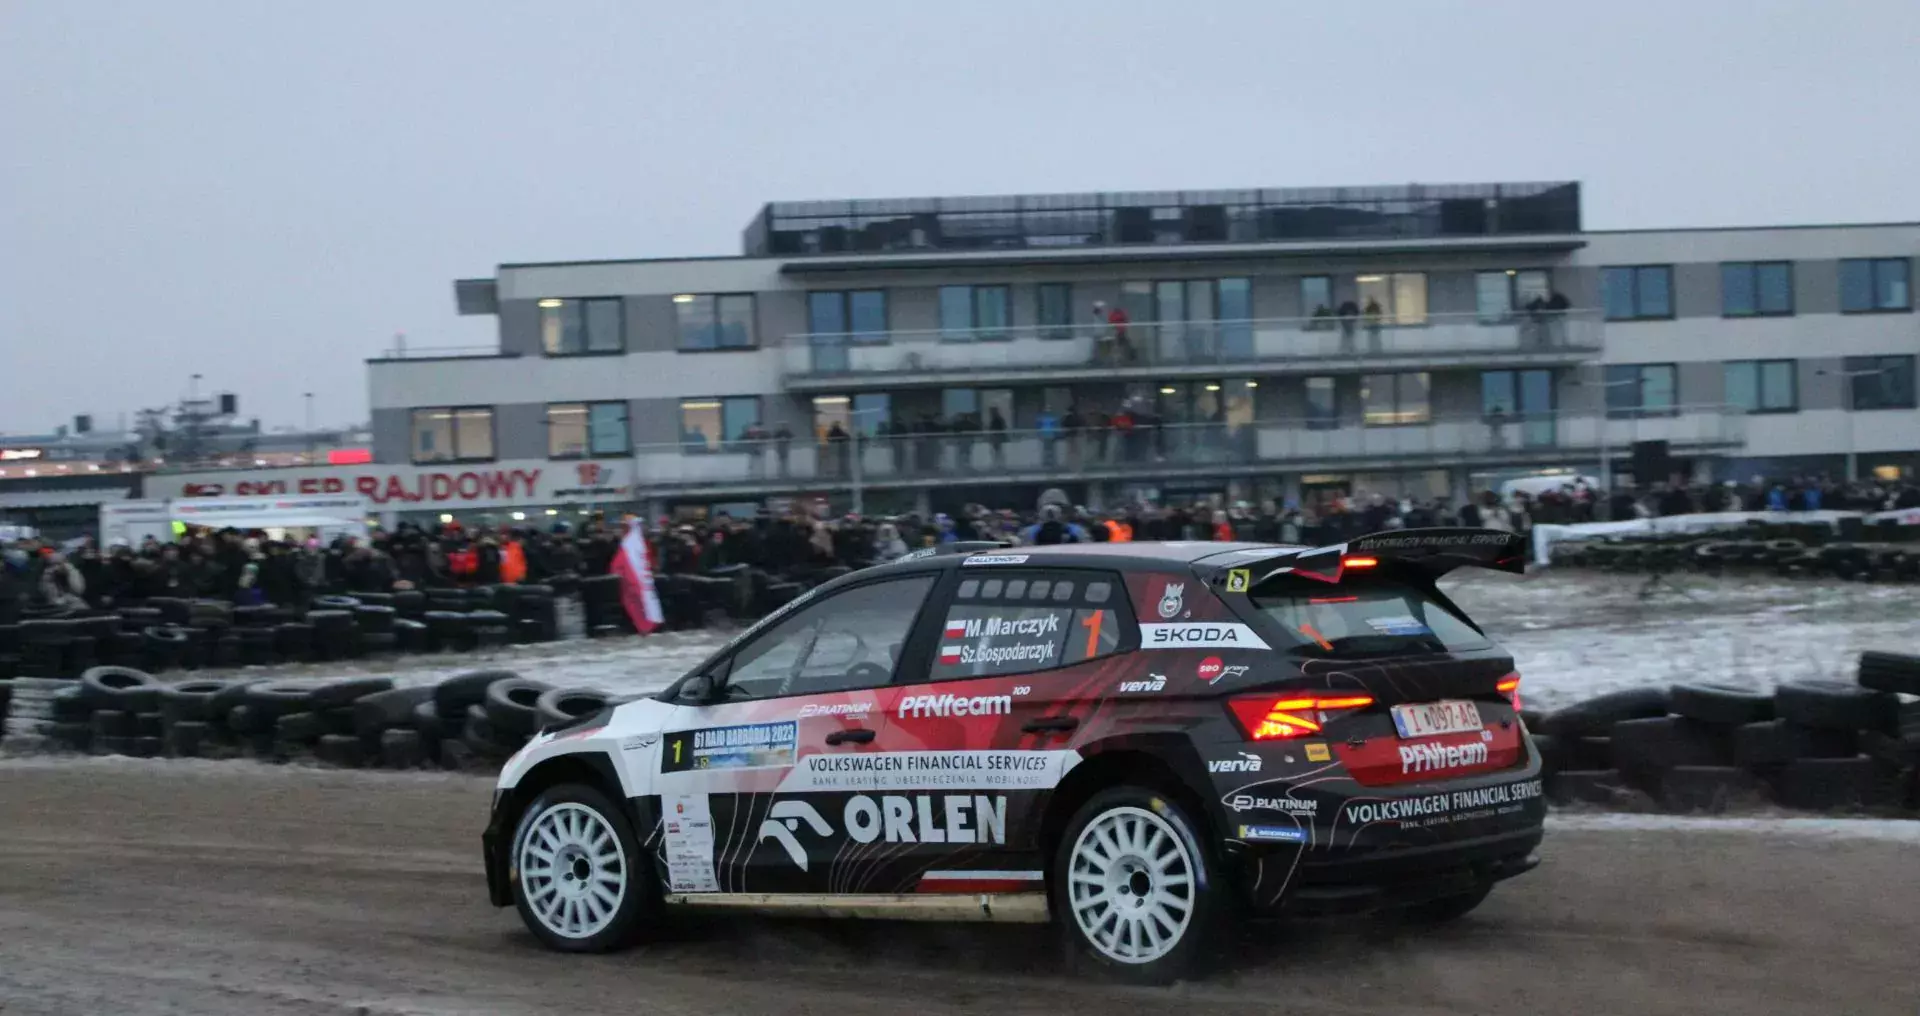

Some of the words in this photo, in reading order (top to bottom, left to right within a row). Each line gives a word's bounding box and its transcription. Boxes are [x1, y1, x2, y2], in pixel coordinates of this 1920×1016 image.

[356, 467, 541, 504] RAJDOWY
[965, 614, 1060, 637] M.Marczyk
[1082, 609, 1104, 658] 1
[959, 640, 1056, 666] Sz.Gospodarczyk
[1119, 676, 1168, 692] verva
[817, 702, 873, 715] PLATINUM
[898, 693, 1012, 719] PFNteam
[694, 731, 705, 749] 61
[771, 724, 795, 743] 2023
[672, 739, 682, 764] 1
[808, 756, 902, 772] VOLKSWAGEN
[907, 755, 983, 771] FINANCIAL
[987, 755, 1048, 771] SERVICES
[1398, 741, 1489, 775] PFNteam
[1208, 756, 1262, 773] verva
[1256, 797, 1317, 810] PLATINUM
[1346, 793, 1450, 825] VOLKSWAGEN
[1453, 785, 1511, 810] FINANCIAL
[843, 794, 1008, 845] ORLEN
